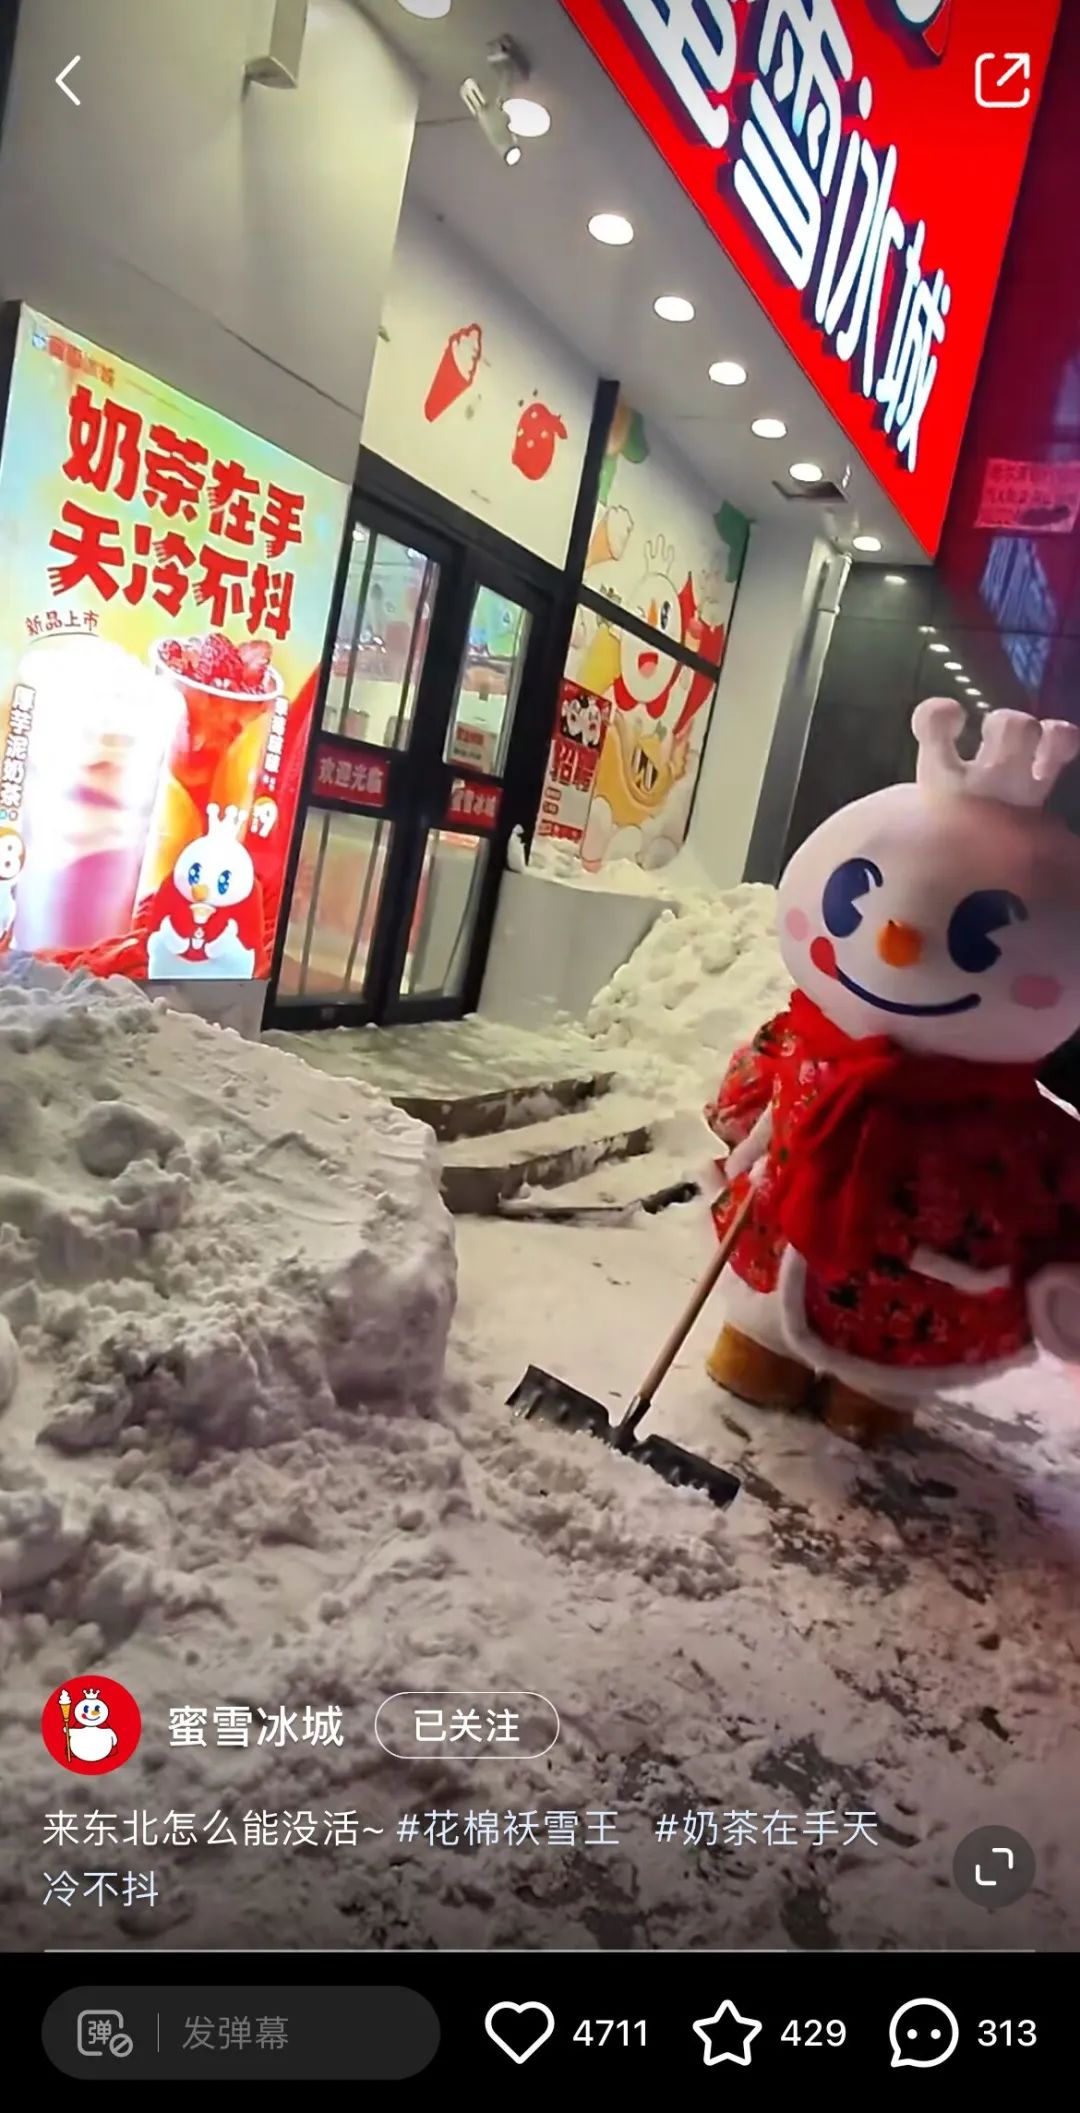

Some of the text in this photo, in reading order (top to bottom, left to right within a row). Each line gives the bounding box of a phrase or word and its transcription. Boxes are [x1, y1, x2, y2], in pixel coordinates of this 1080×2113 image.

[62, 384, 304, 558] 奶茶在手
[47, 500, 294, 639] 天冷不抖
[25, 610, 99, 636] 新品上市
[319, 757, 383, 794] 欢迎光临
